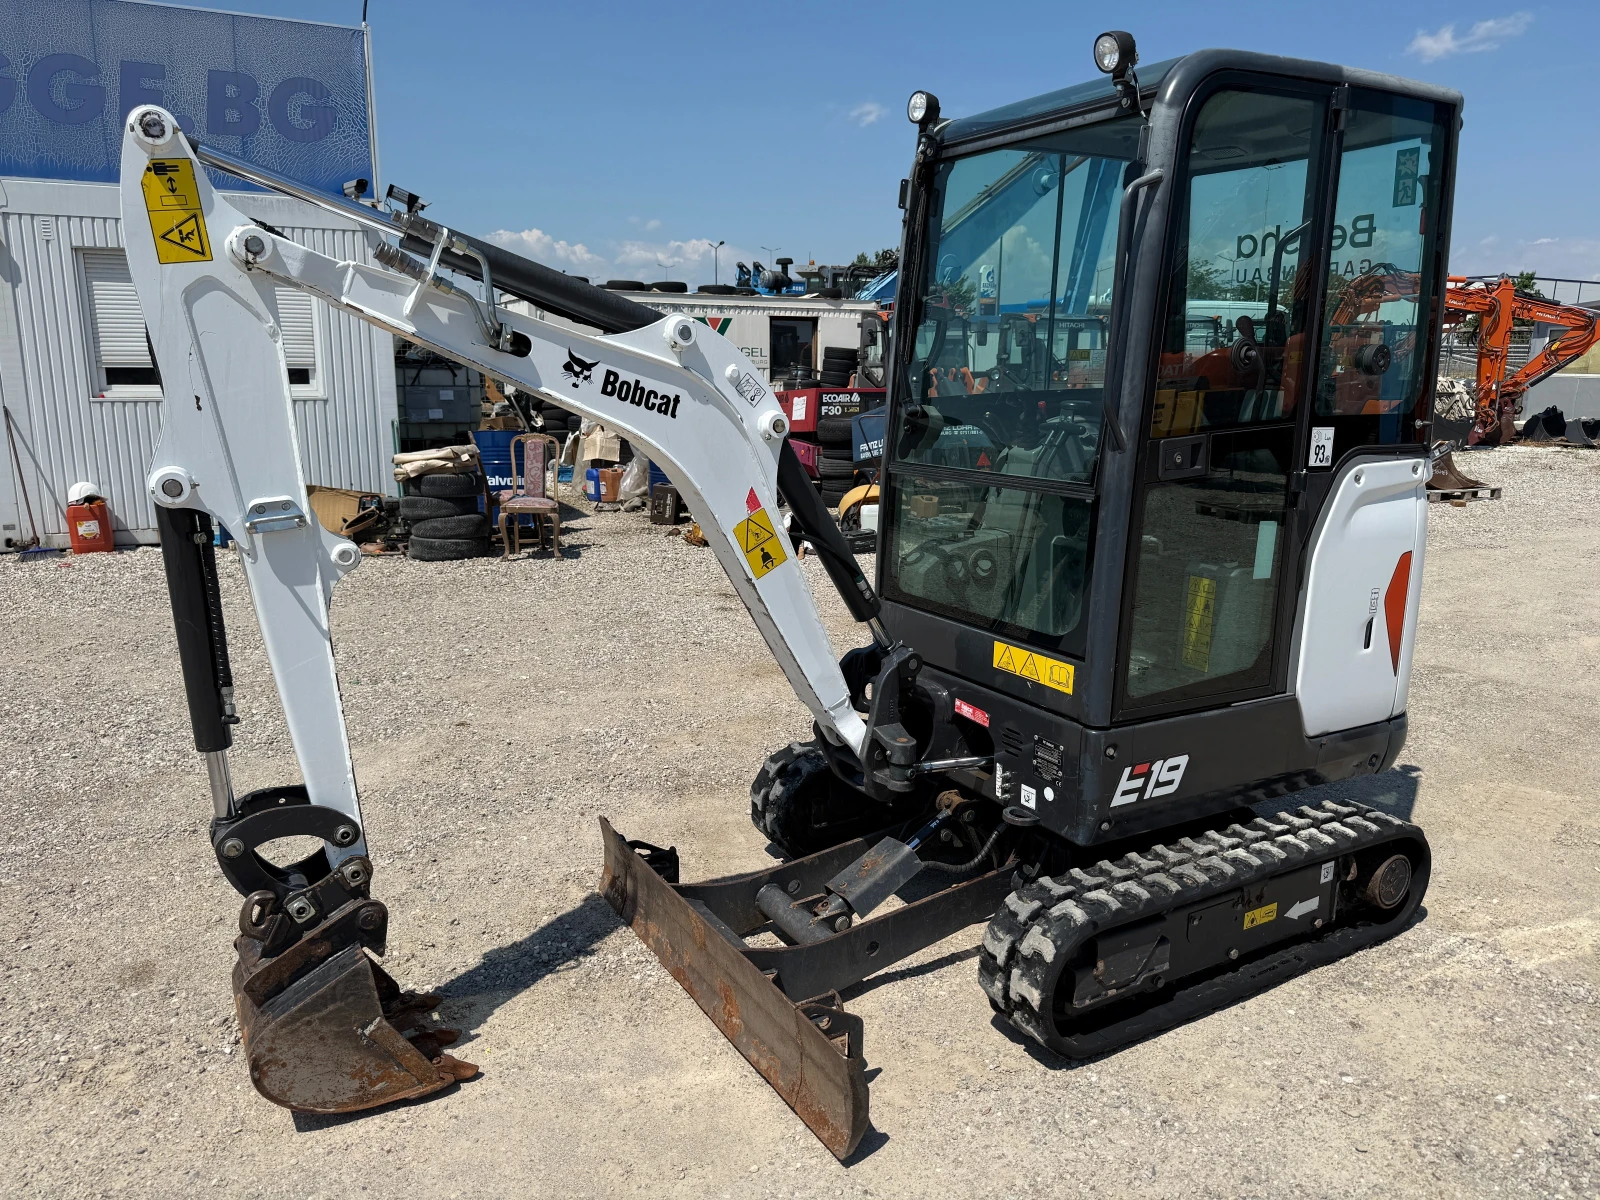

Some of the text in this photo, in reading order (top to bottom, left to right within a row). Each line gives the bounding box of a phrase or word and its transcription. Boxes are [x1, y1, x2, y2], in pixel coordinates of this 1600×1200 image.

[1058, 321, 1085, 329] HITACHI
[600, 368, 681, 419] Bobcat
[822, 393, 851, 403] ECOAIR
[821, 405, 842, 416] F30
[1314, 444, 1326, 464] 93
[1109, 754, 1190, 808] E19
